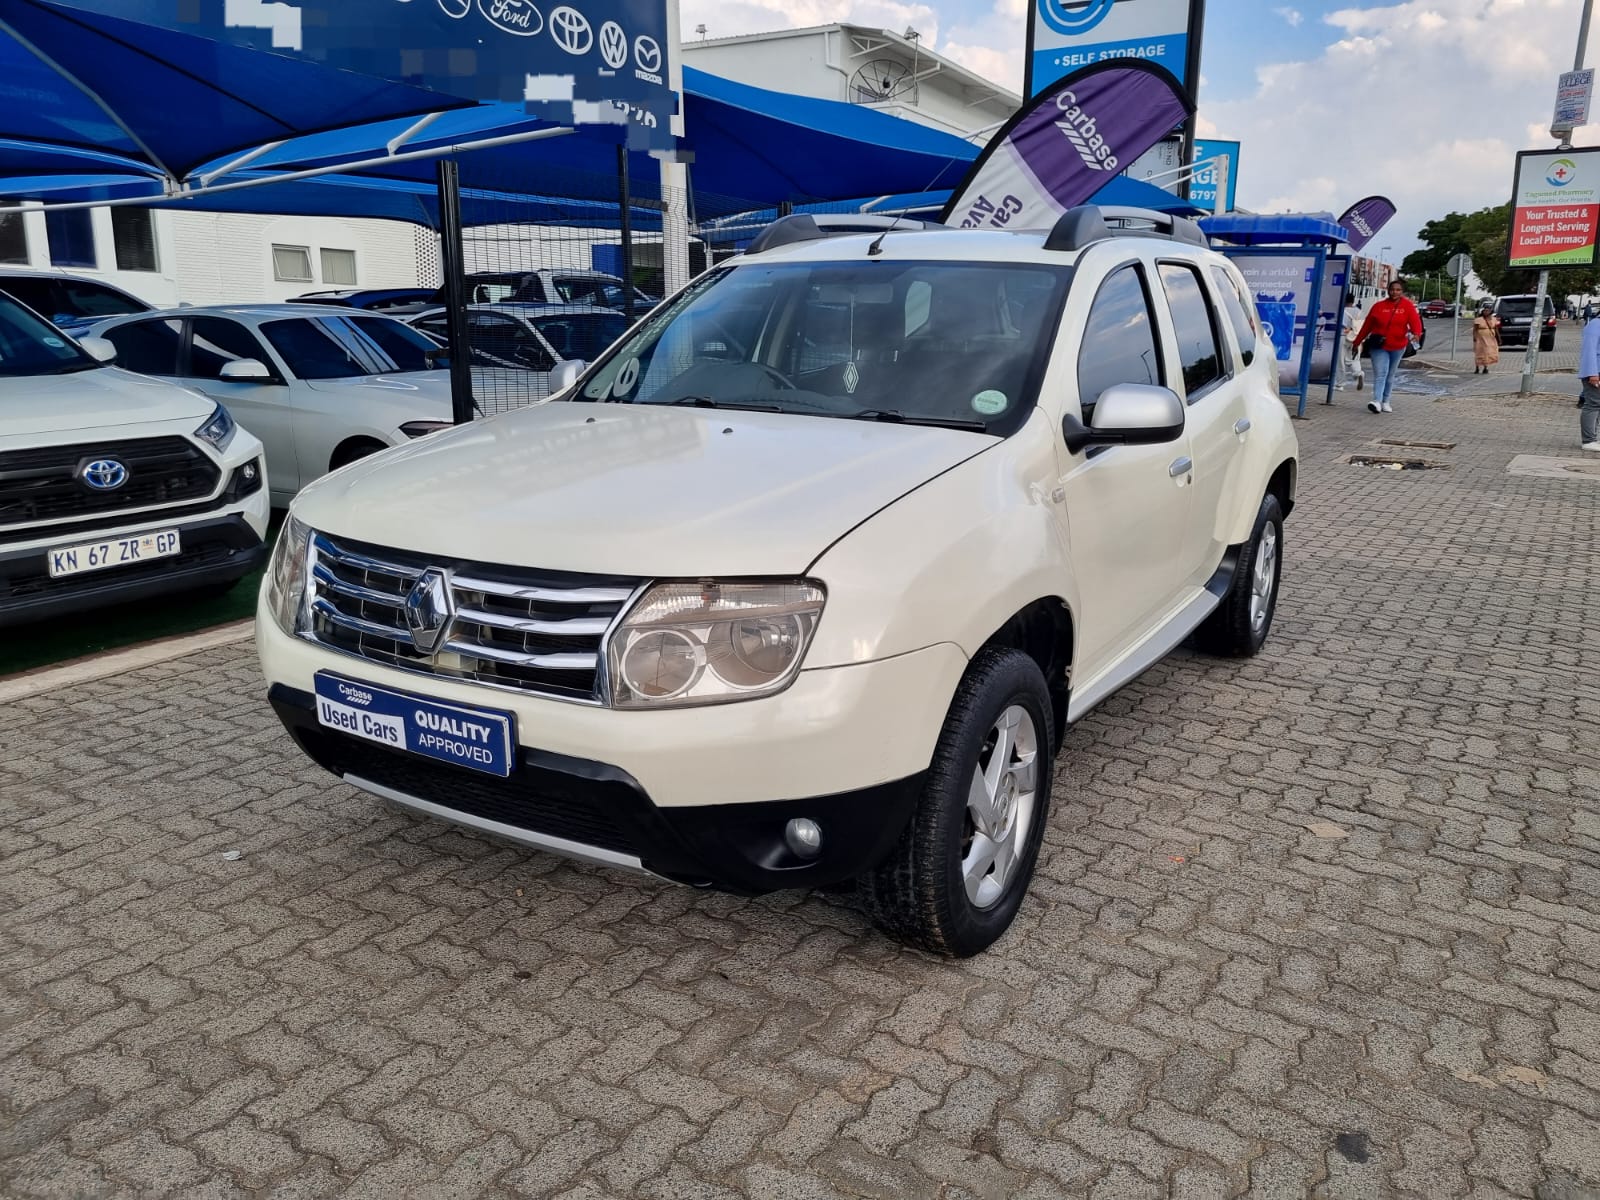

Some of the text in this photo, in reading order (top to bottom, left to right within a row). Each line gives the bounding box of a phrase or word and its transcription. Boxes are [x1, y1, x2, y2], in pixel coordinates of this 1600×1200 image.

[490, 0, 531, 28] Ford
[1062, 44, 1165, 67] SELF STORAGE
[1056, 91, 1118, 172] Carbase
[1351, 210, 1374, 237] Carbase
[1526, 208, 1588, 220] Your Trusted &
[1519, 234, 1588, 246] Local Pharmacy
[1521, 222, 1590, 234] Longest Serving
[1260, 289, 1289, 298] design
[54, 533, 176, 573] KN 67 ZR GP
[339, 683, 373, 701] Carbase
[321, 702, 398, 742] Used Cars
[415, 710, 491, 743] QUALITY
[419, 733, 493, 765] APPROVED
